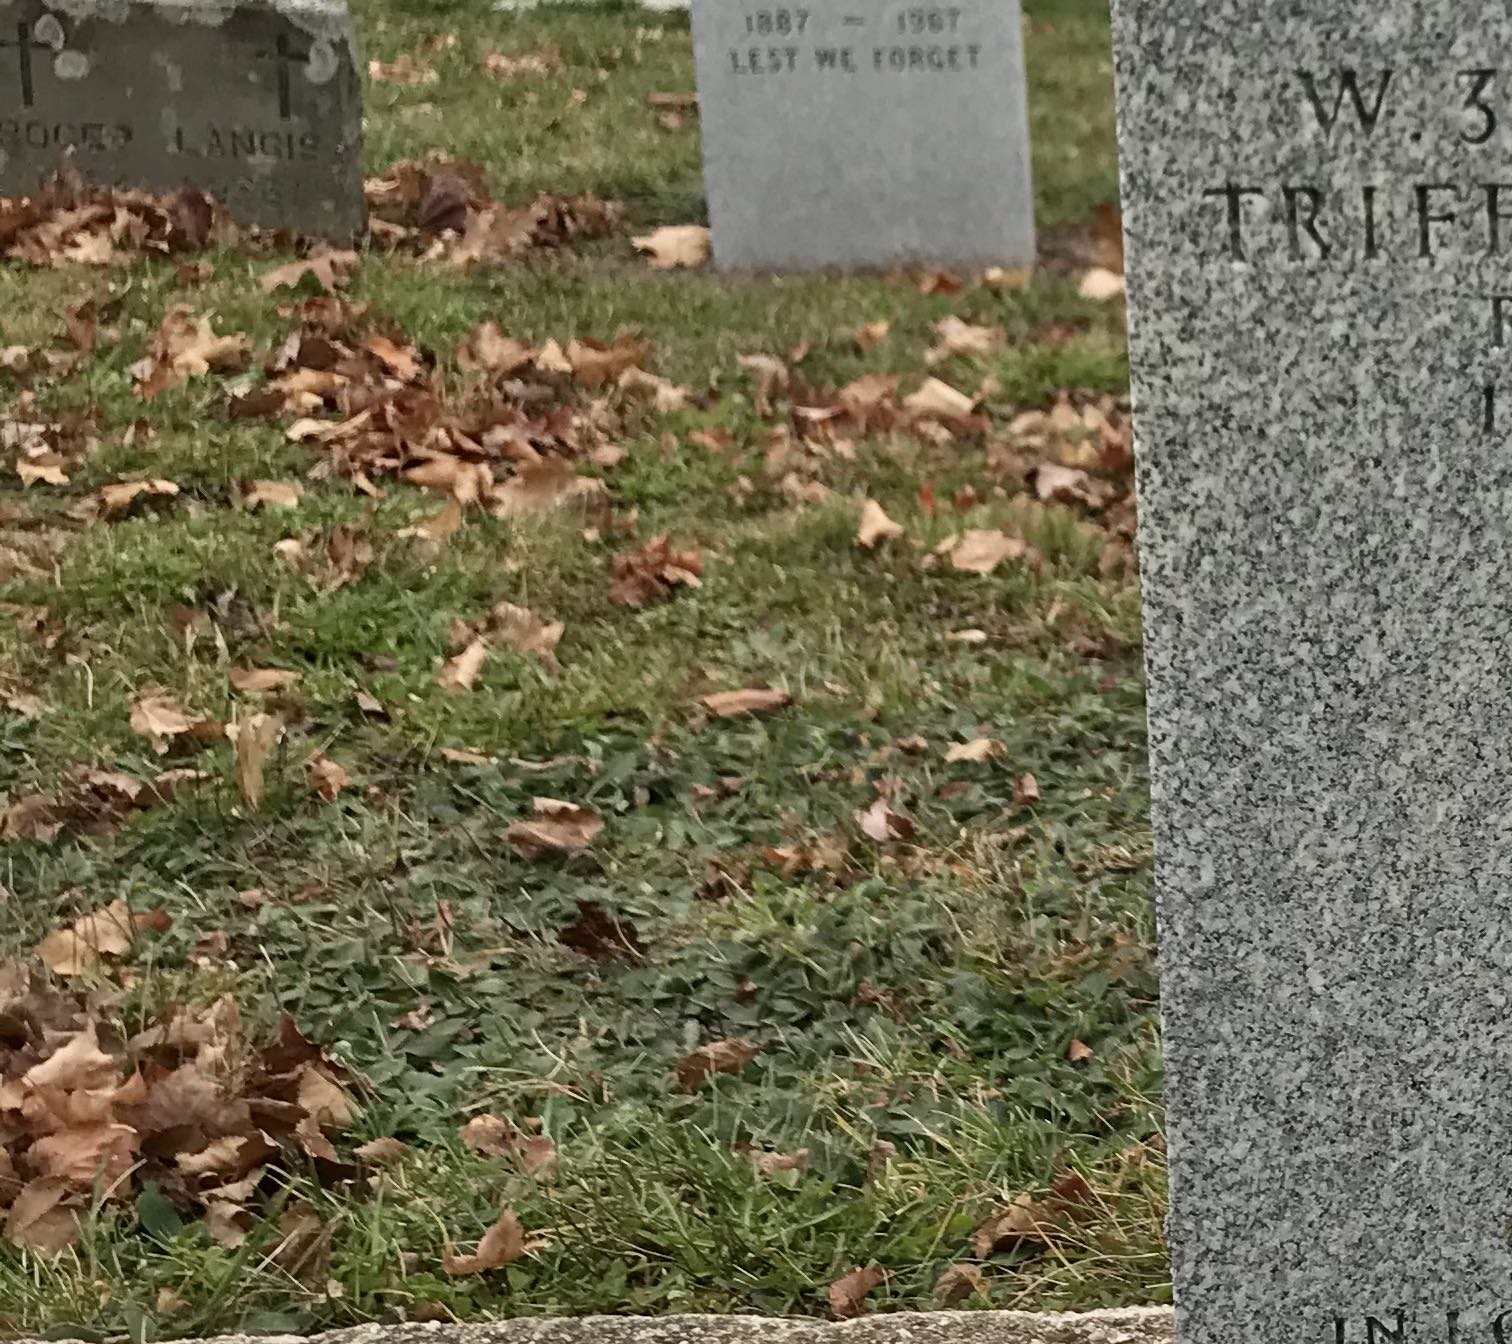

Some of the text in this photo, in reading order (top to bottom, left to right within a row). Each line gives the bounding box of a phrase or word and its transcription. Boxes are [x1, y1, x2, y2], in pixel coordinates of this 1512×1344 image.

[727, 43, 982, 75] LEST WE FORGET
